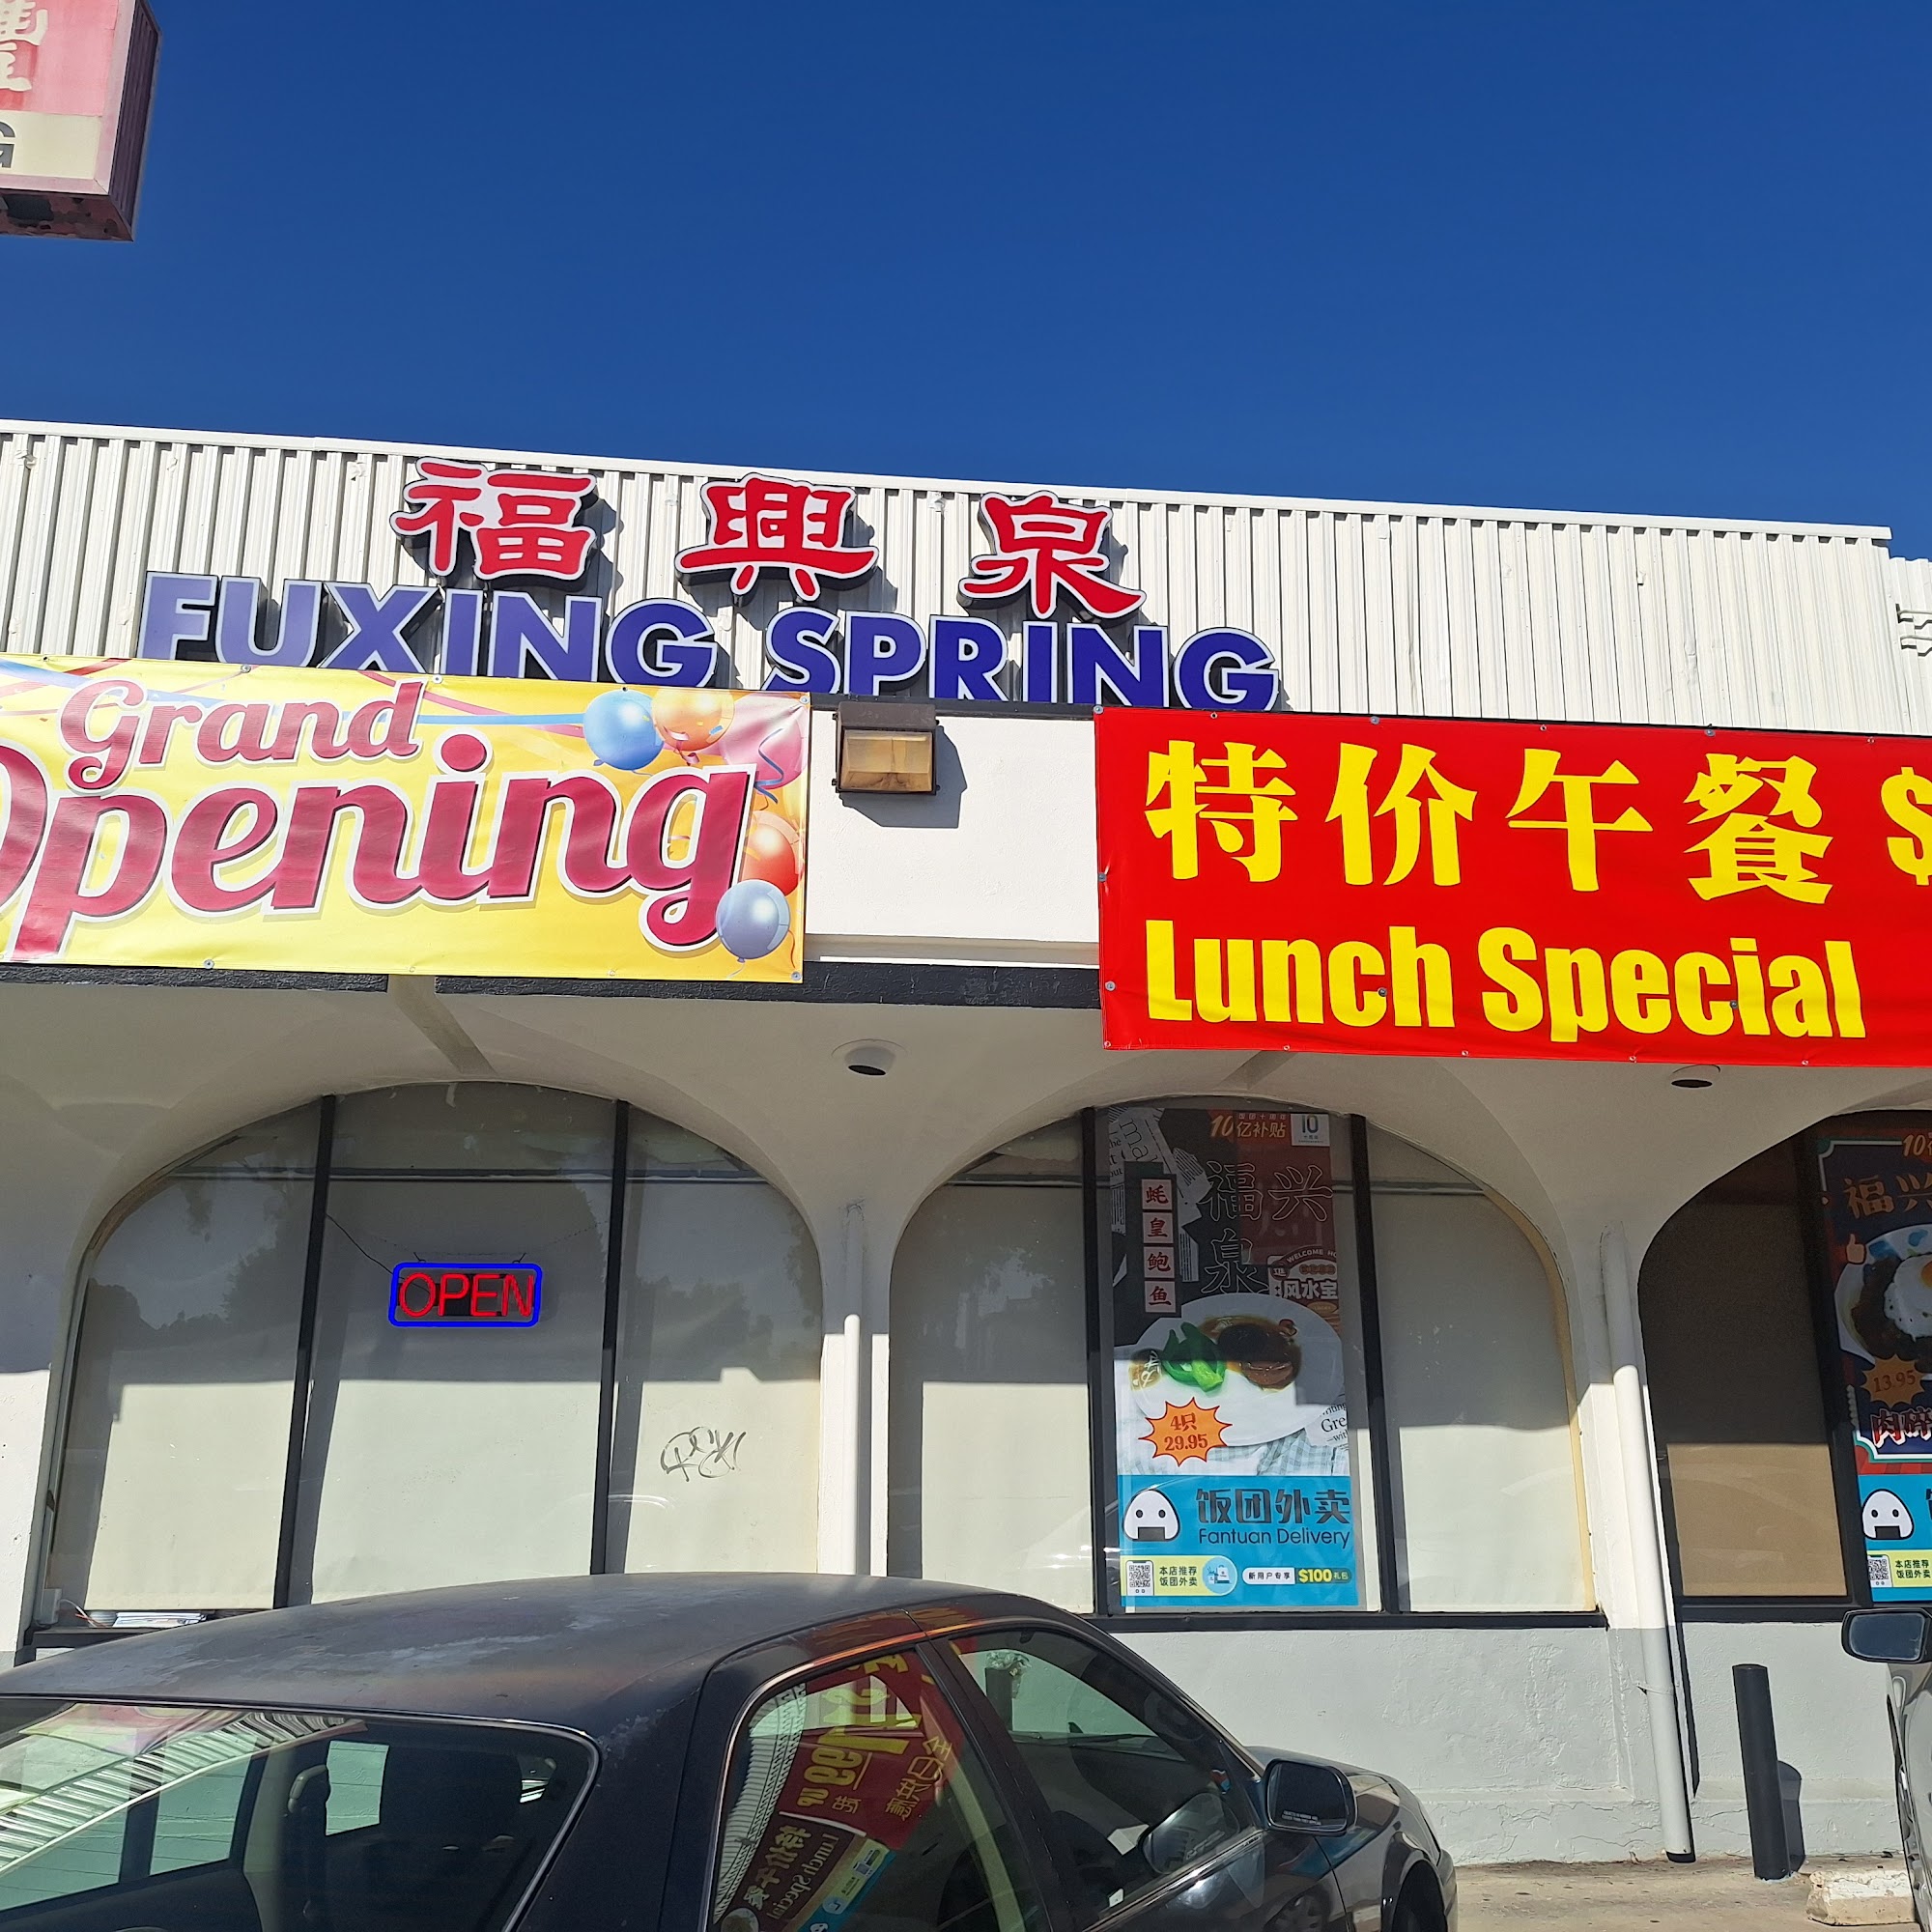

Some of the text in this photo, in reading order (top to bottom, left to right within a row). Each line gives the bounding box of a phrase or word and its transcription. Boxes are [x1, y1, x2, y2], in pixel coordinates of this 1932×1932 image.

[389, 456, 1147, 620] 福興泉
[137, 571, 1280, 712] FUXING SPRING
[60, 678, 426, 791] Grand
[1144, 740, 1835, 904] 特价午餐
[1146, 920, 1866, 1042] Lunch Special
[1287, 1249, 1323, 1264] WELCOME
[399, 1272, 534, 1318] OPEN
[1873, 1370, 1916, 1392] 13.95
[1170, 1412, 1197, 1431] 4只
[1164, 1434, 1208, 1451] 29.95
[1196, 1489, 1350, 1523] 饭团外卖
[1199, 1529, 1350, 1548] Fantuan Delivery
[1159, 1566, 1198, 1576] 本店推荐
[1159, 1577, 1198, 1586] 饭团外卖
